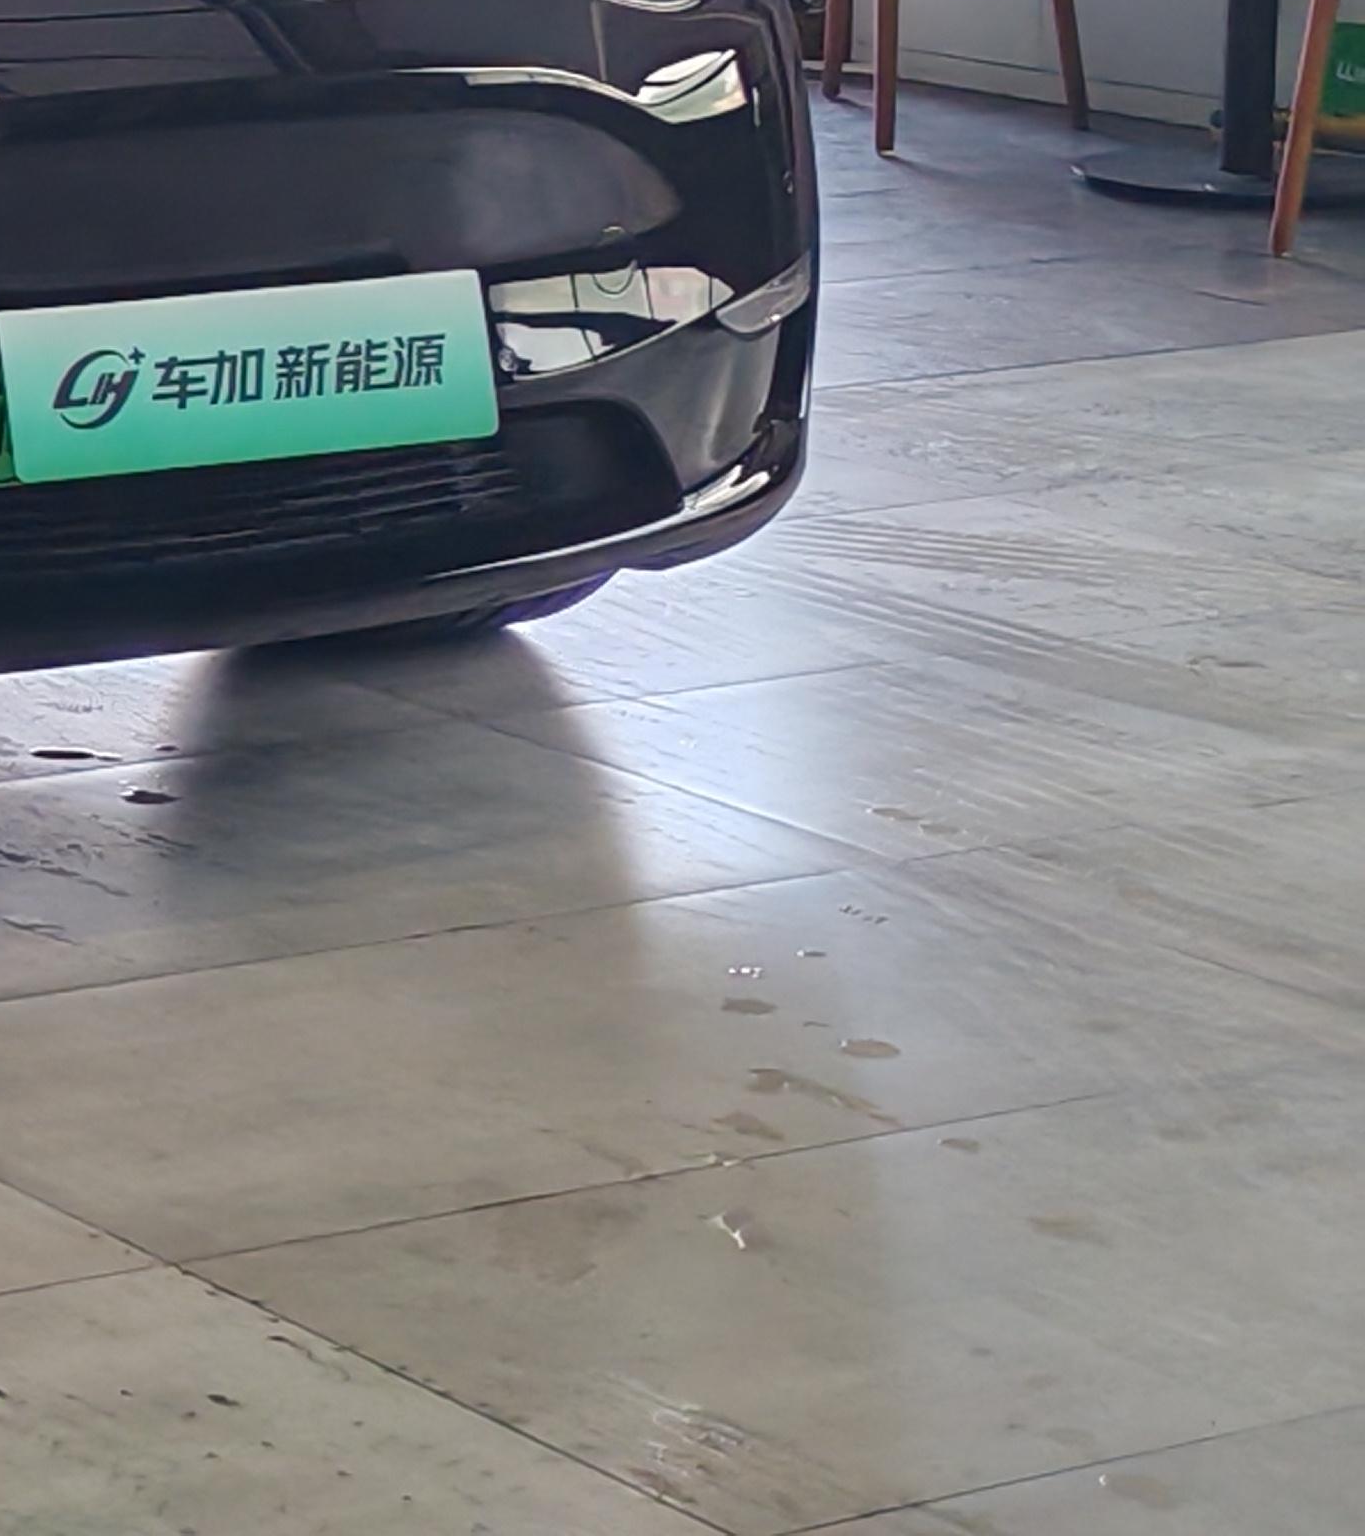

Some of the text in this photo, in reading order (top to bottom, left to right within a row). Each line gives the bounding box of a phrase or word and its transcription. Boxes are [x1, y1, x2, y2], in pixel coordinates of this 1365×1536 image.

[152, 332, 446, 411] 车加新能源
